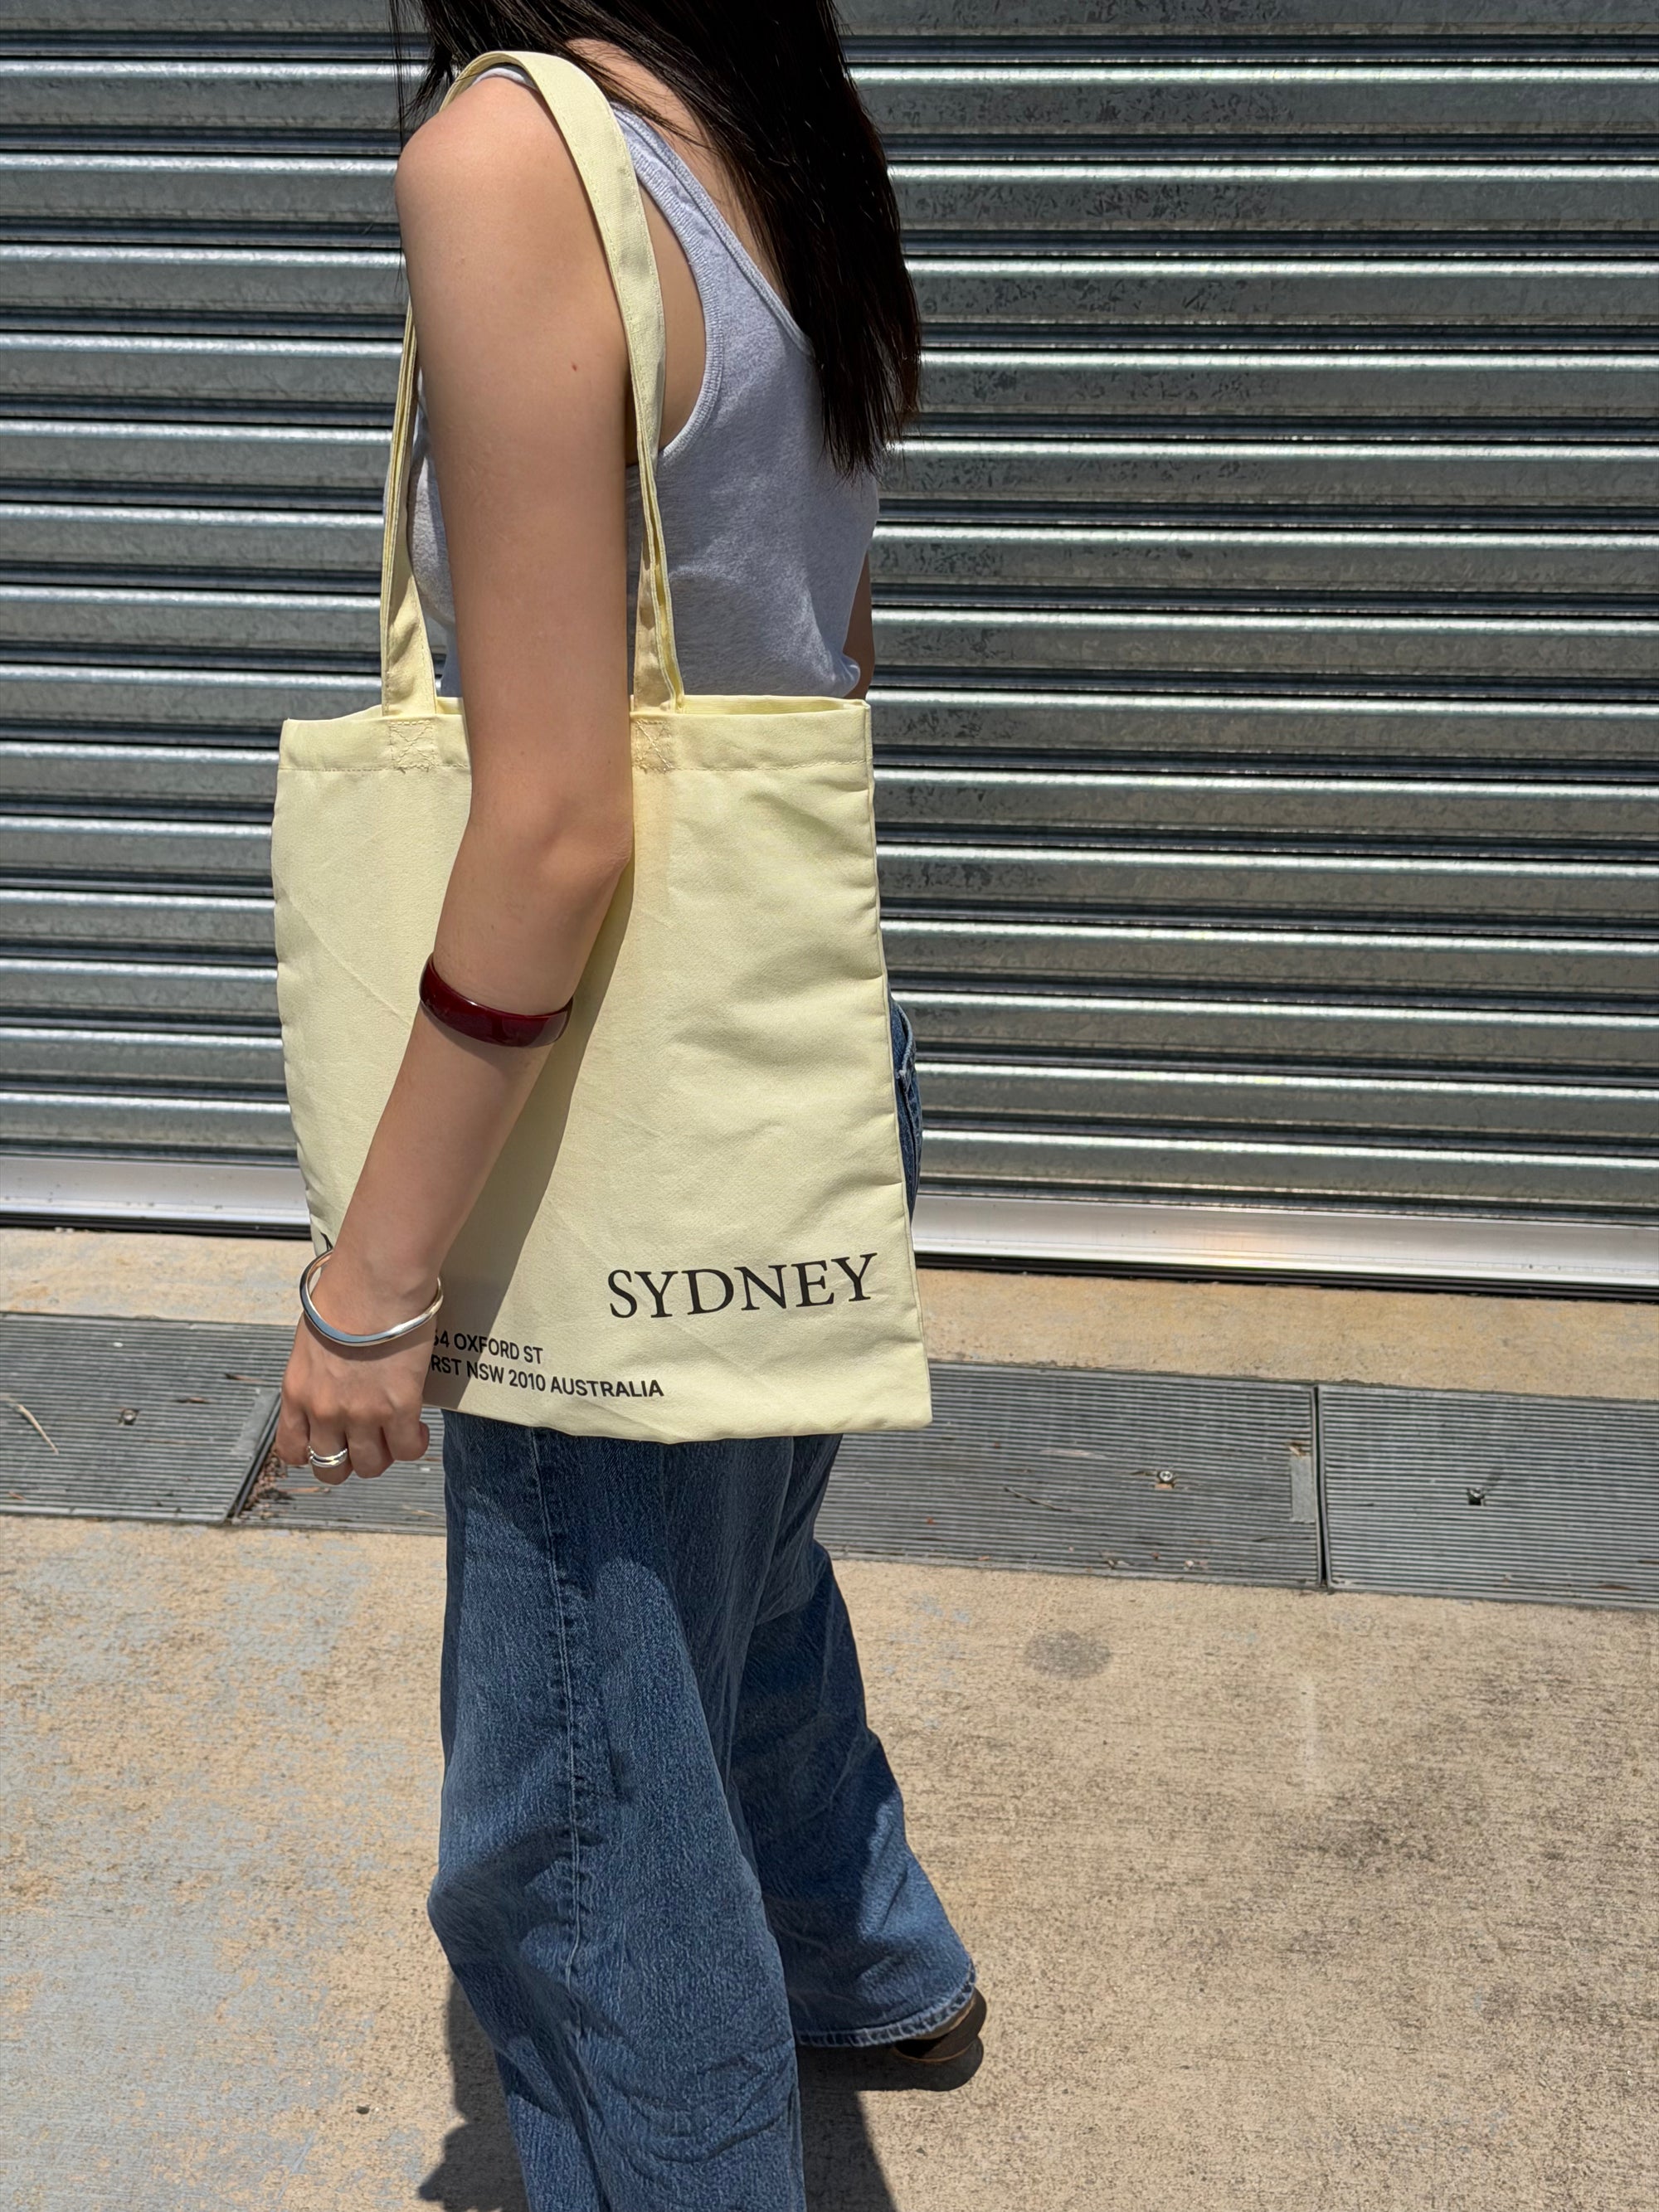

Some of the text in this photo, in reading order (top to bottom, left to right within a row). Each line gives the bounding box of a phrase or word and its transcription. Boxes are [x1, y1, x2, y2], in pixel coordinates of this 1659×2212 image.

[607, 1252, 878, 1319] SYDNEY
[453, 1332, 521, 1360] OXFORD
[523, 1345, 544, 1364] ST
[465, 1360, 505, 1384] NSW
[508, 1369, 547, 1392] 2010
[549, 1376, 665, 1398] AUSTRALIA
